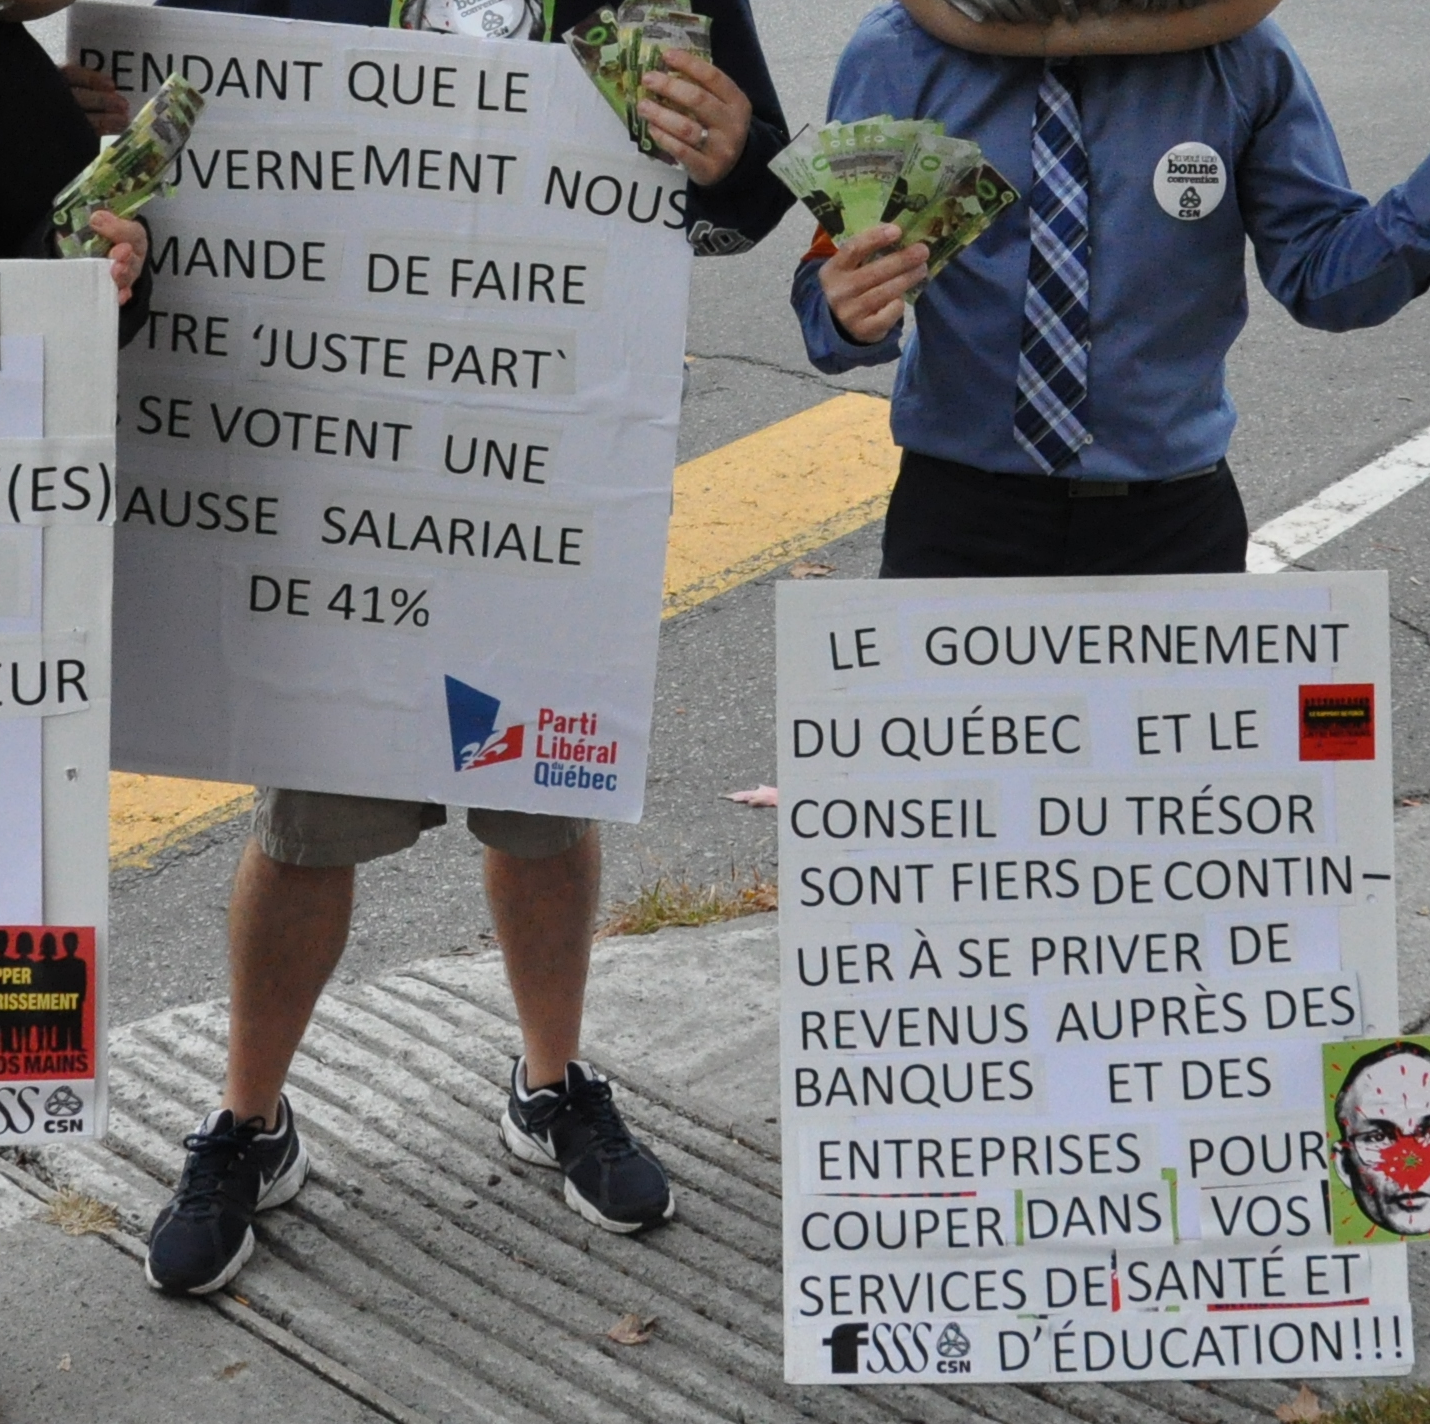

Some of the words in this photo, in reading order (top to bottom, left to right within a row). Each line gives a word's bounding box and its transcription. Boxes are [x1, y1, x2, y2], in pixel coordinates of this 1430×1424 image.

[79, 48, 324, 102] PENDANT
[348, 60, 457, 109] QUE
[477, 69, 529, 113] LE
[1167, 159, 1217, 174] bonne
[544, 165, 688, 230] NOUS
[1178, 209, 1200, 217] CSN
[367, 253, 430, 296] DE
[451, 258, 587, 305] FAIRE
[136, 395, 193, 439] SE
[209, 401, 413, 462] VOTENT
[444, 434, 549, 485] UNE
[321, 506, 583, 566] SALARIALE
[249, 574, 311, 617] DE
[327, 583, 430, 627] 41%
[829, 627, 881, 671] LE
[925, 623, 1350, 666] GOUVERNEMENT
[538, 708, 597, 735] Parti
[793, 718, 861, 758] DU
[881, 704, 1081, 762] QUÉBEC
[1137, 713, 1191, 755] ET
[1209, 709, 1259, 751] LE
[536, 735, 617, 764] Libéral
[552, 762, 563, 770] du
[534, 761, 617, 791] Québec
[790, 798, 997, 839] CONSEIL
[1040, 796, 1107, 837] DU
[1125, 784, 1315, 836] TRÉSOR
[800, 863, 934, 907] SONT
[952, 858, 1080, 902] FIERS
[1093, 864, 1154, 905] DE
[797, 943, 894, 987] UER
[909, 928, 942, 980] À
[958, 937, 1012, 979] SE
[1031, 932, 1202, 977] PRIVER
[1230, 923, 1292, 966] DE
[801, 1003, 1029, 1051] REVENUS
[1056, 982, 1247, 1043] AUPRÈS
[1265, 985, 1355, 1030] DES
[24, 1054, 88, 1073] MAINS
[795, 1059, 1034, 1109] BANQUES
[1108, 1061, 1163, 1104] ET
[1181, 1056, 1271, 1101] DES
[44, 1119, 83, 1133] CSN
[819, 1132, 1141, 1181] ENTREPRISES
[1189, 1130, 1328, 1179] POUR
[801, 1207, 1004, 1252] COUPER
[1026, 1191, 1162, 1240] DANS
[1210, 1195, 1311, 1237] VOS
[799, 1268, 1027, 1317] SERVICES
[1046, 1265, 1108, 1308] DE
[1127, 1244, 1286, 1302] SANTÉ
[1305, 1253, 1361, 1296] ET
[937, 1360, 971, 1374] CSN
